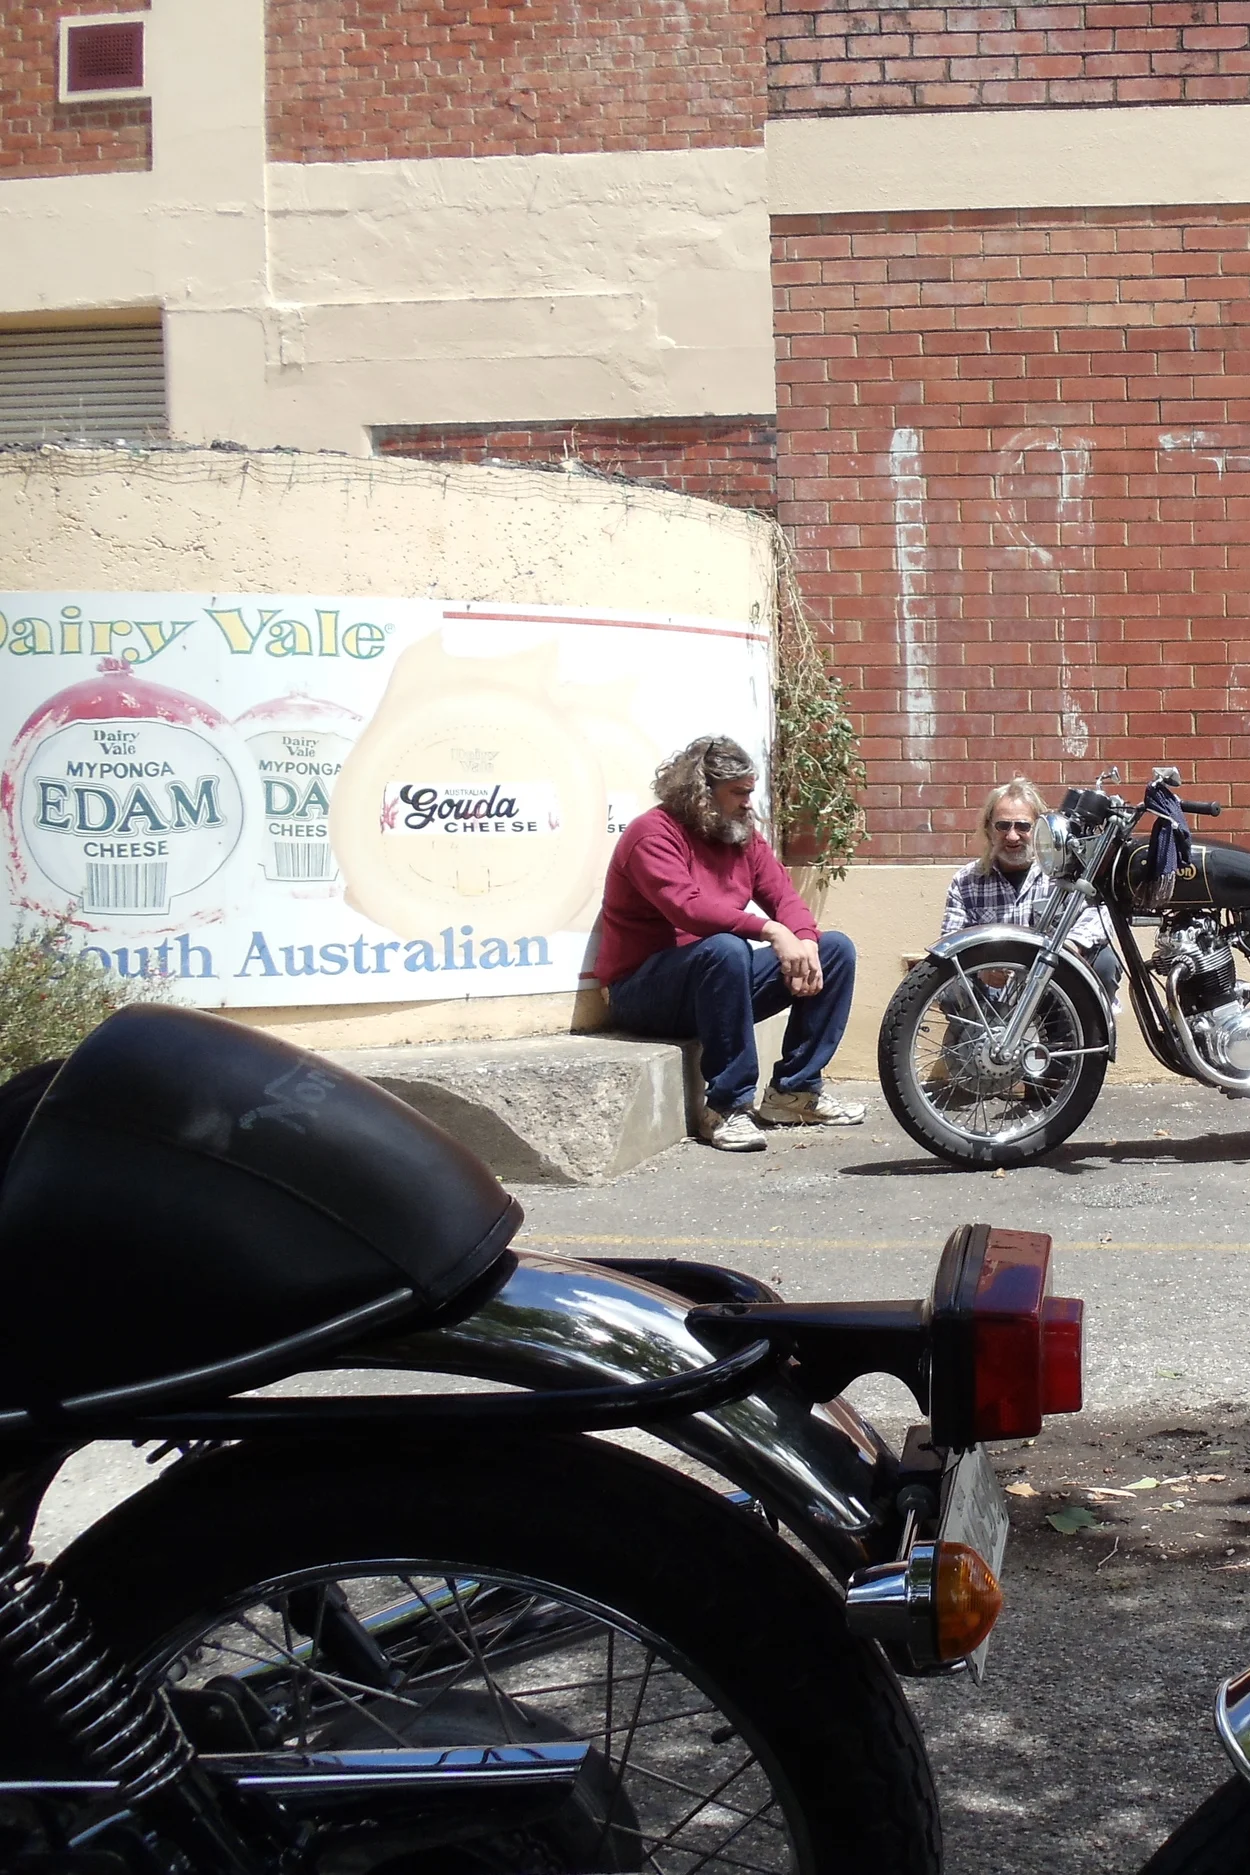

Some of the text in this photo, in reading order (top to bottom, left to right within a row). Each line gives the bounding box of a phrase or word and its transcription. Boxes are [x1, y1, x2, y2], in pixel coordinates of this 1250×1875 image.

[0, 605, 197, 665] airy
[93, 729, 140, 743] Dairy
[282, 736, 319, 748] Dairy
[101, 742, 136, 755] Vale
[286, 746, 316, 757] Vale
[66, 760, 175, 778] MYPONGA
[444, 788, 489, 796] AUSTRALIAN
[36, 776, 224, 834] EDAM
[399, 784, 519, 830] Gouda
[443, 821, 538, 833] CHEESE
[83, 840, 169, 858] CHEESE
[49, 925, 554, 980] outh Australian
